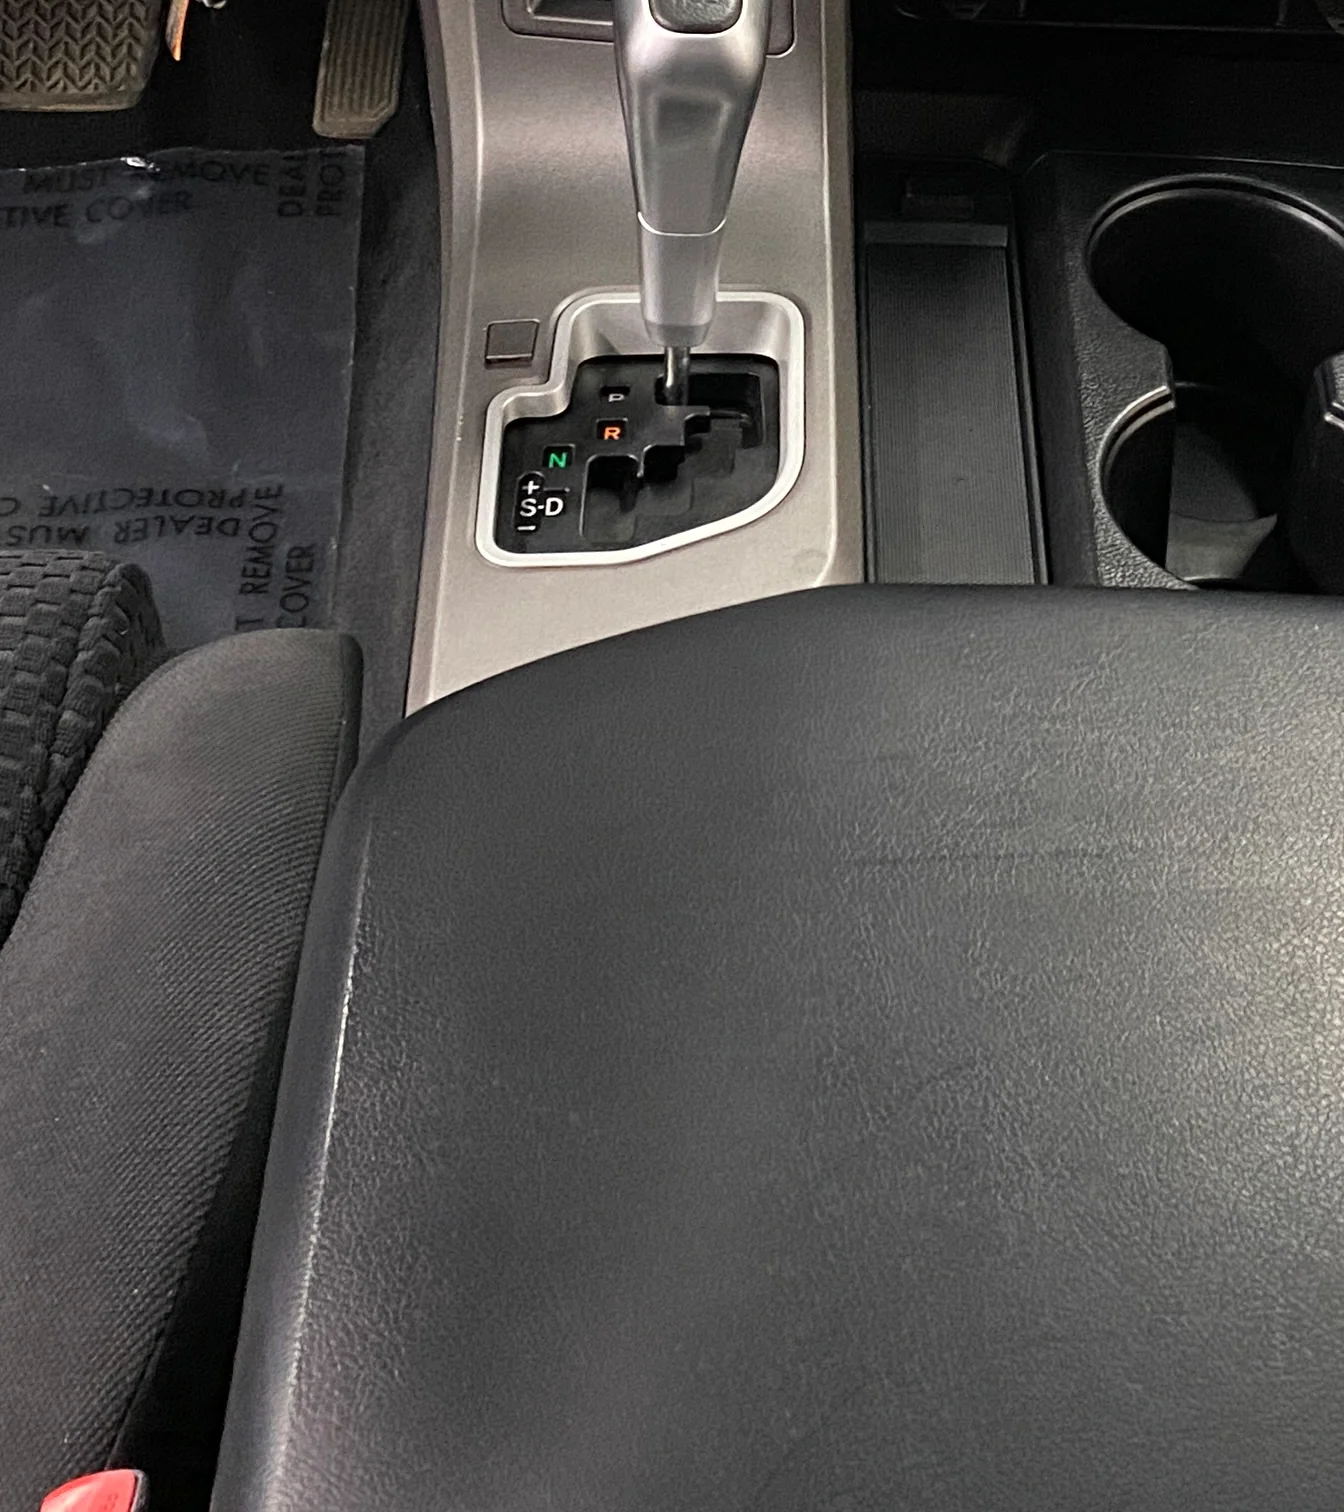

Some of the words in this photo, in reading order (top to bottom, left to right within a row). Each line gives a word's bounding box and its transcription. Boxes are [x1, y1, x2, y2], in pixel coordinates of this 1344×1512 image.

[23, 164, 109, 195] MUST
[83, 189, 194, 224] COVER
[603, 426, 621, 440] R
[547, 452, 568, 469] N
[37, 486, 246, 518] PROTECTIVE
[113, 514, 242, 545] DEALER
[238, 483, 286, 596] REMOVE
